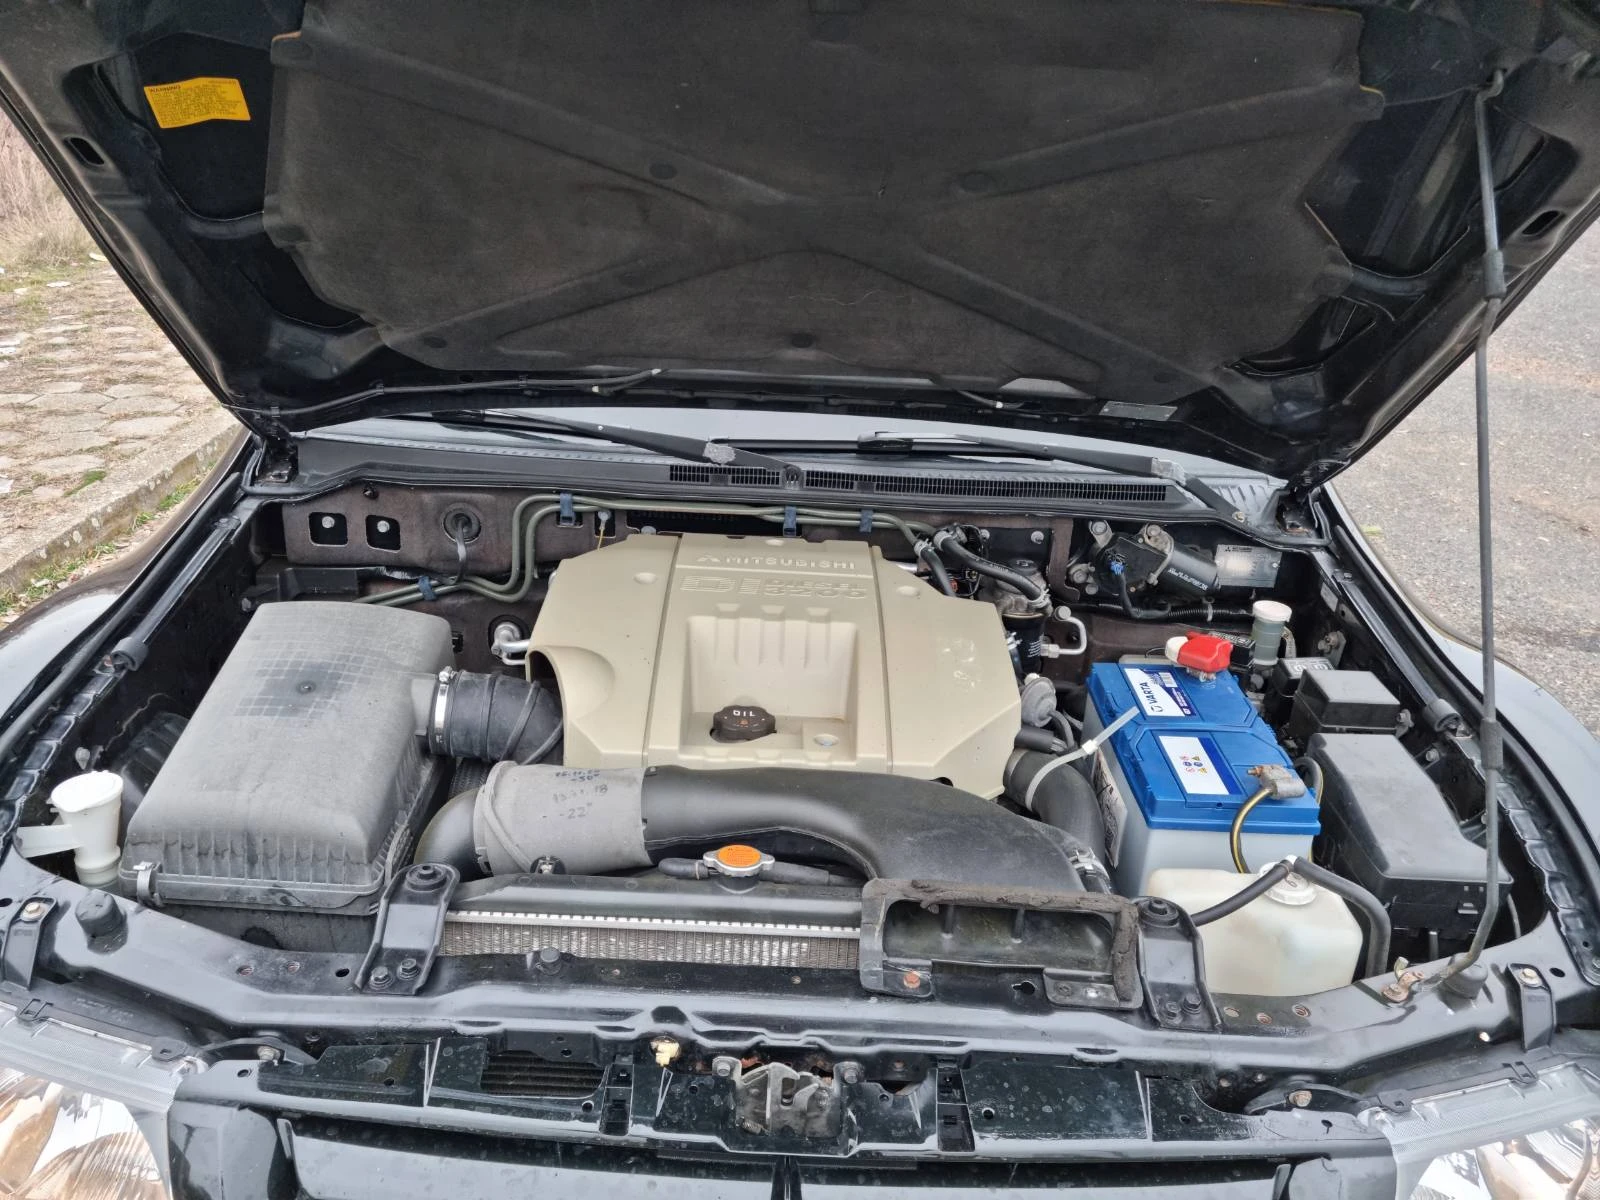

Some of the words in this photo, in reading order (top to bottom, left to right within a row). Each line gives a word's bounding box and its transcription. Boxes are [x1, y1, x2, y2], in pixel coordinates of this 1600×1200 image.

[726, 556, 856, 570] MITSUBISHI
[1139, 682, 1158, 705] VARTA
[732, 709, 756, 717] OIL
